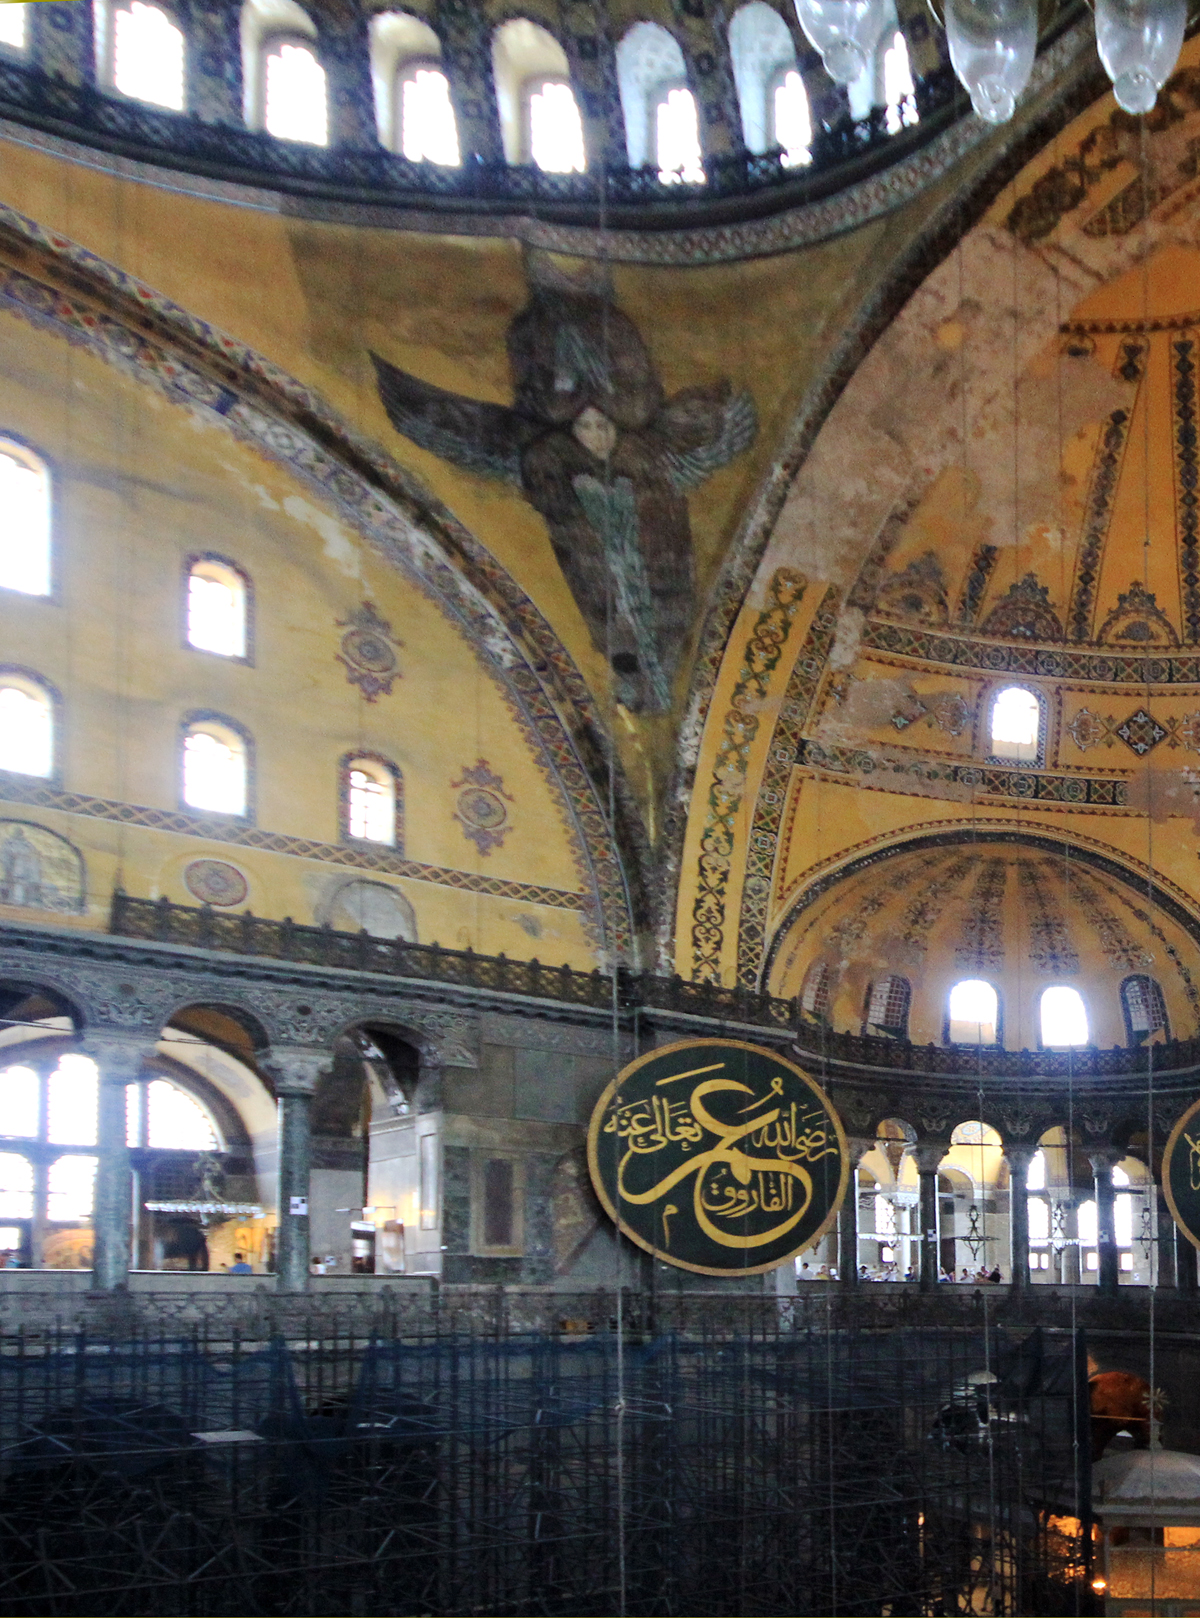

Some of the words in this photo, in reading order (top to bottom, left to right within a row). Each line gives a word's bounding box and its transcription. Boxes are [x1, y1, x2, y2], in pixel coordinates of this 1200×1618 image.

[751, 1102, 797, 1148] الله
[617, 1078, 813, 1248] عمر
[701, 1172, 793, 1219] الفاروق
